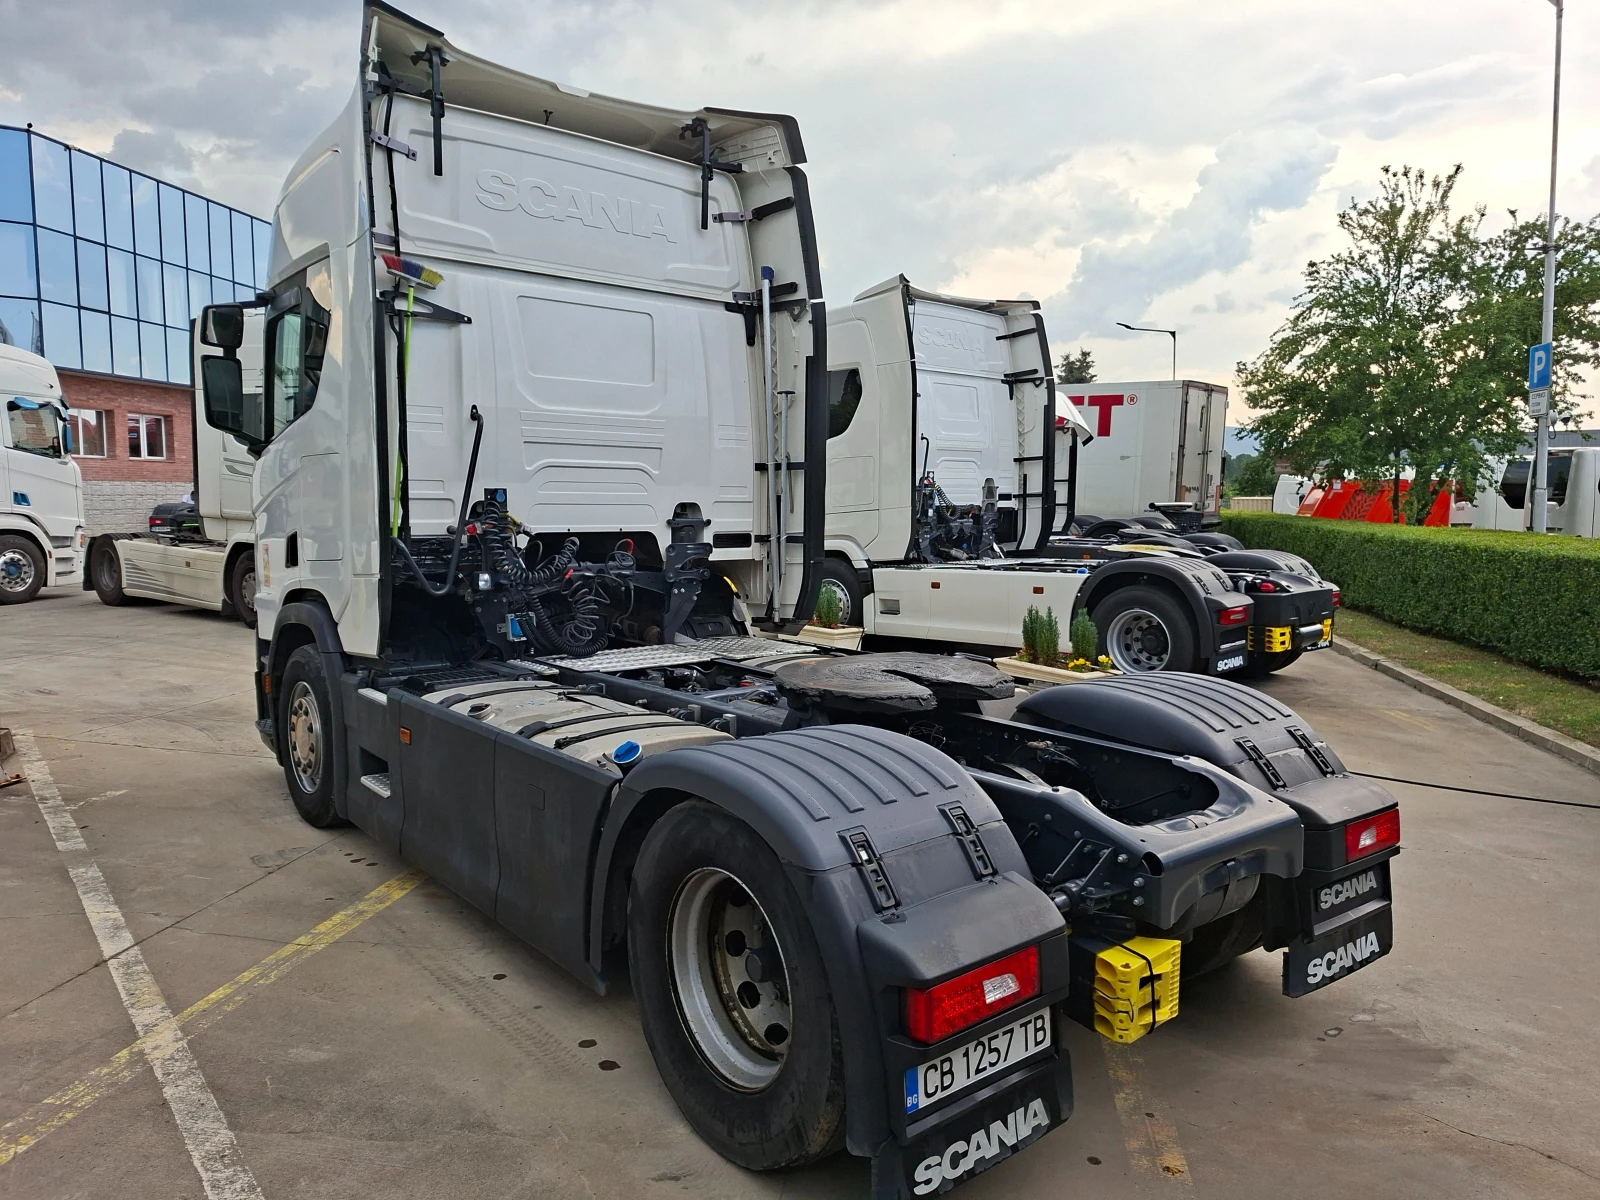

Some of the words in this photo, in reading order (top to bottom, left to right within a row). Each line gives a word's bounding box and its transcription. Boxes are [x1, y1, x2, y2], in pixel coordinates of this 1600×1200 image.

[475, 168, 677, 244] SCANIA
[918, 325, 985, 353] SCANIA
[1534, 350, 1546, 383] P
[1216, 655, 1244, 671] SCANIA
[1319, 870, 1377, 910] SCANIA
[1306, 931, 1380, 984] SCANIA
[923, 1056, 955, 1100] CB
[962, 1030, 1014, 1080] 1257
[1019, 1014, 1047, 1053] TB
[906, 1094, 918, 1107] BG
[913, 1097, 1050, 1196] SCANIA
